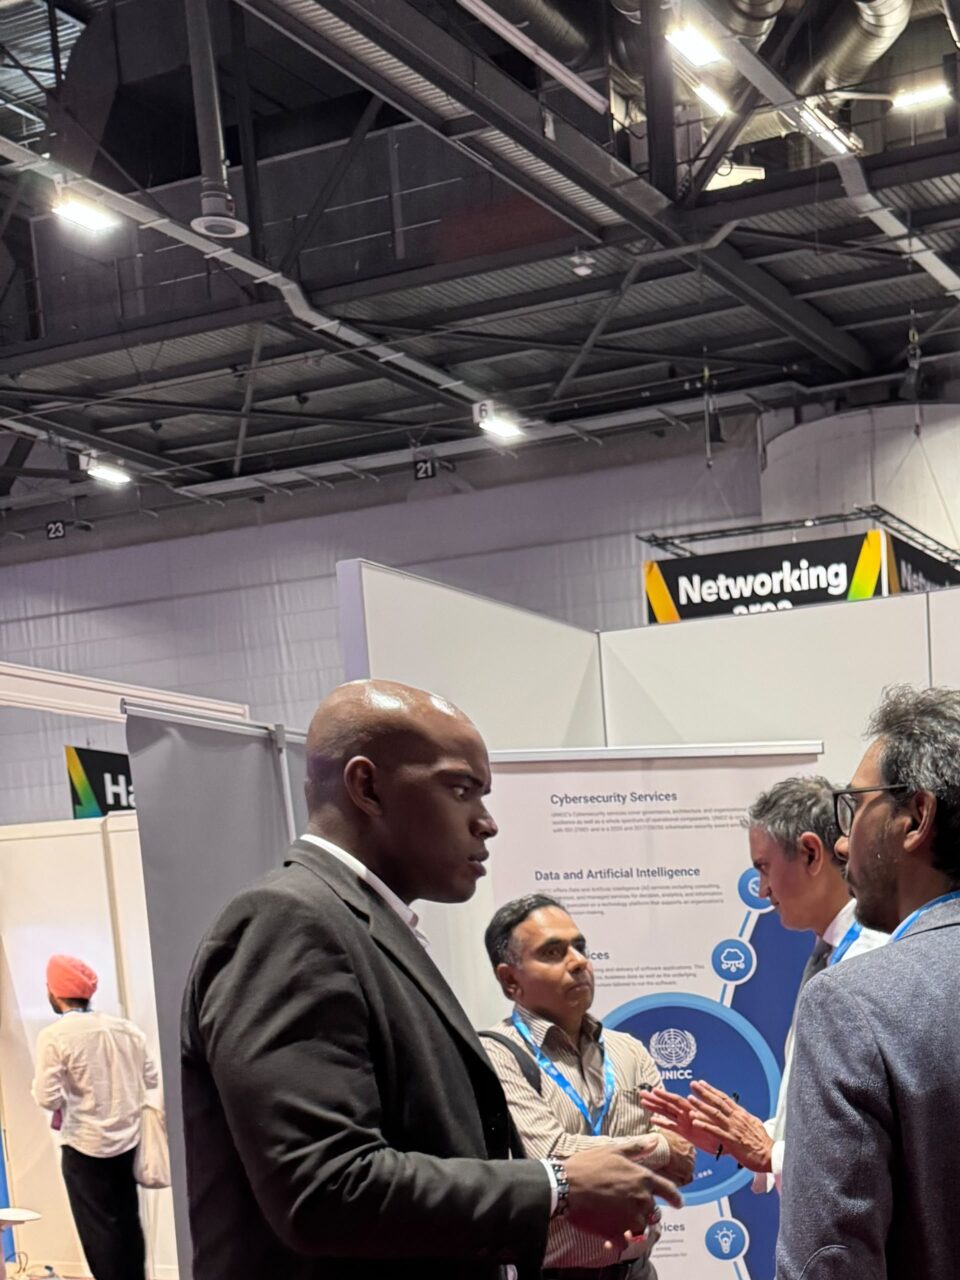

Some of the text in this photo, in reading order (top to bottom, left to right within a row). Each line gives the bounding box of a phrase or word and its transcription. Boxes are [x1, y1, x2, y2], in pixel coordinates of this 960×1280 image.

[478, 402, 489, 420] 6
[416, 461, 432, 478] 21
[47, 522, 64, 538] 23
[678, 558, 848, 605] Networking
[550, 790, 678, 807] Cybersecurity Services
[534, 866, 701, 881] Data and Artificial Intelligence
[587, 950, 610, 960] ices
[659, 1069, 693, 1080] UNICC
[660, 1222, 686, 1232] ices
